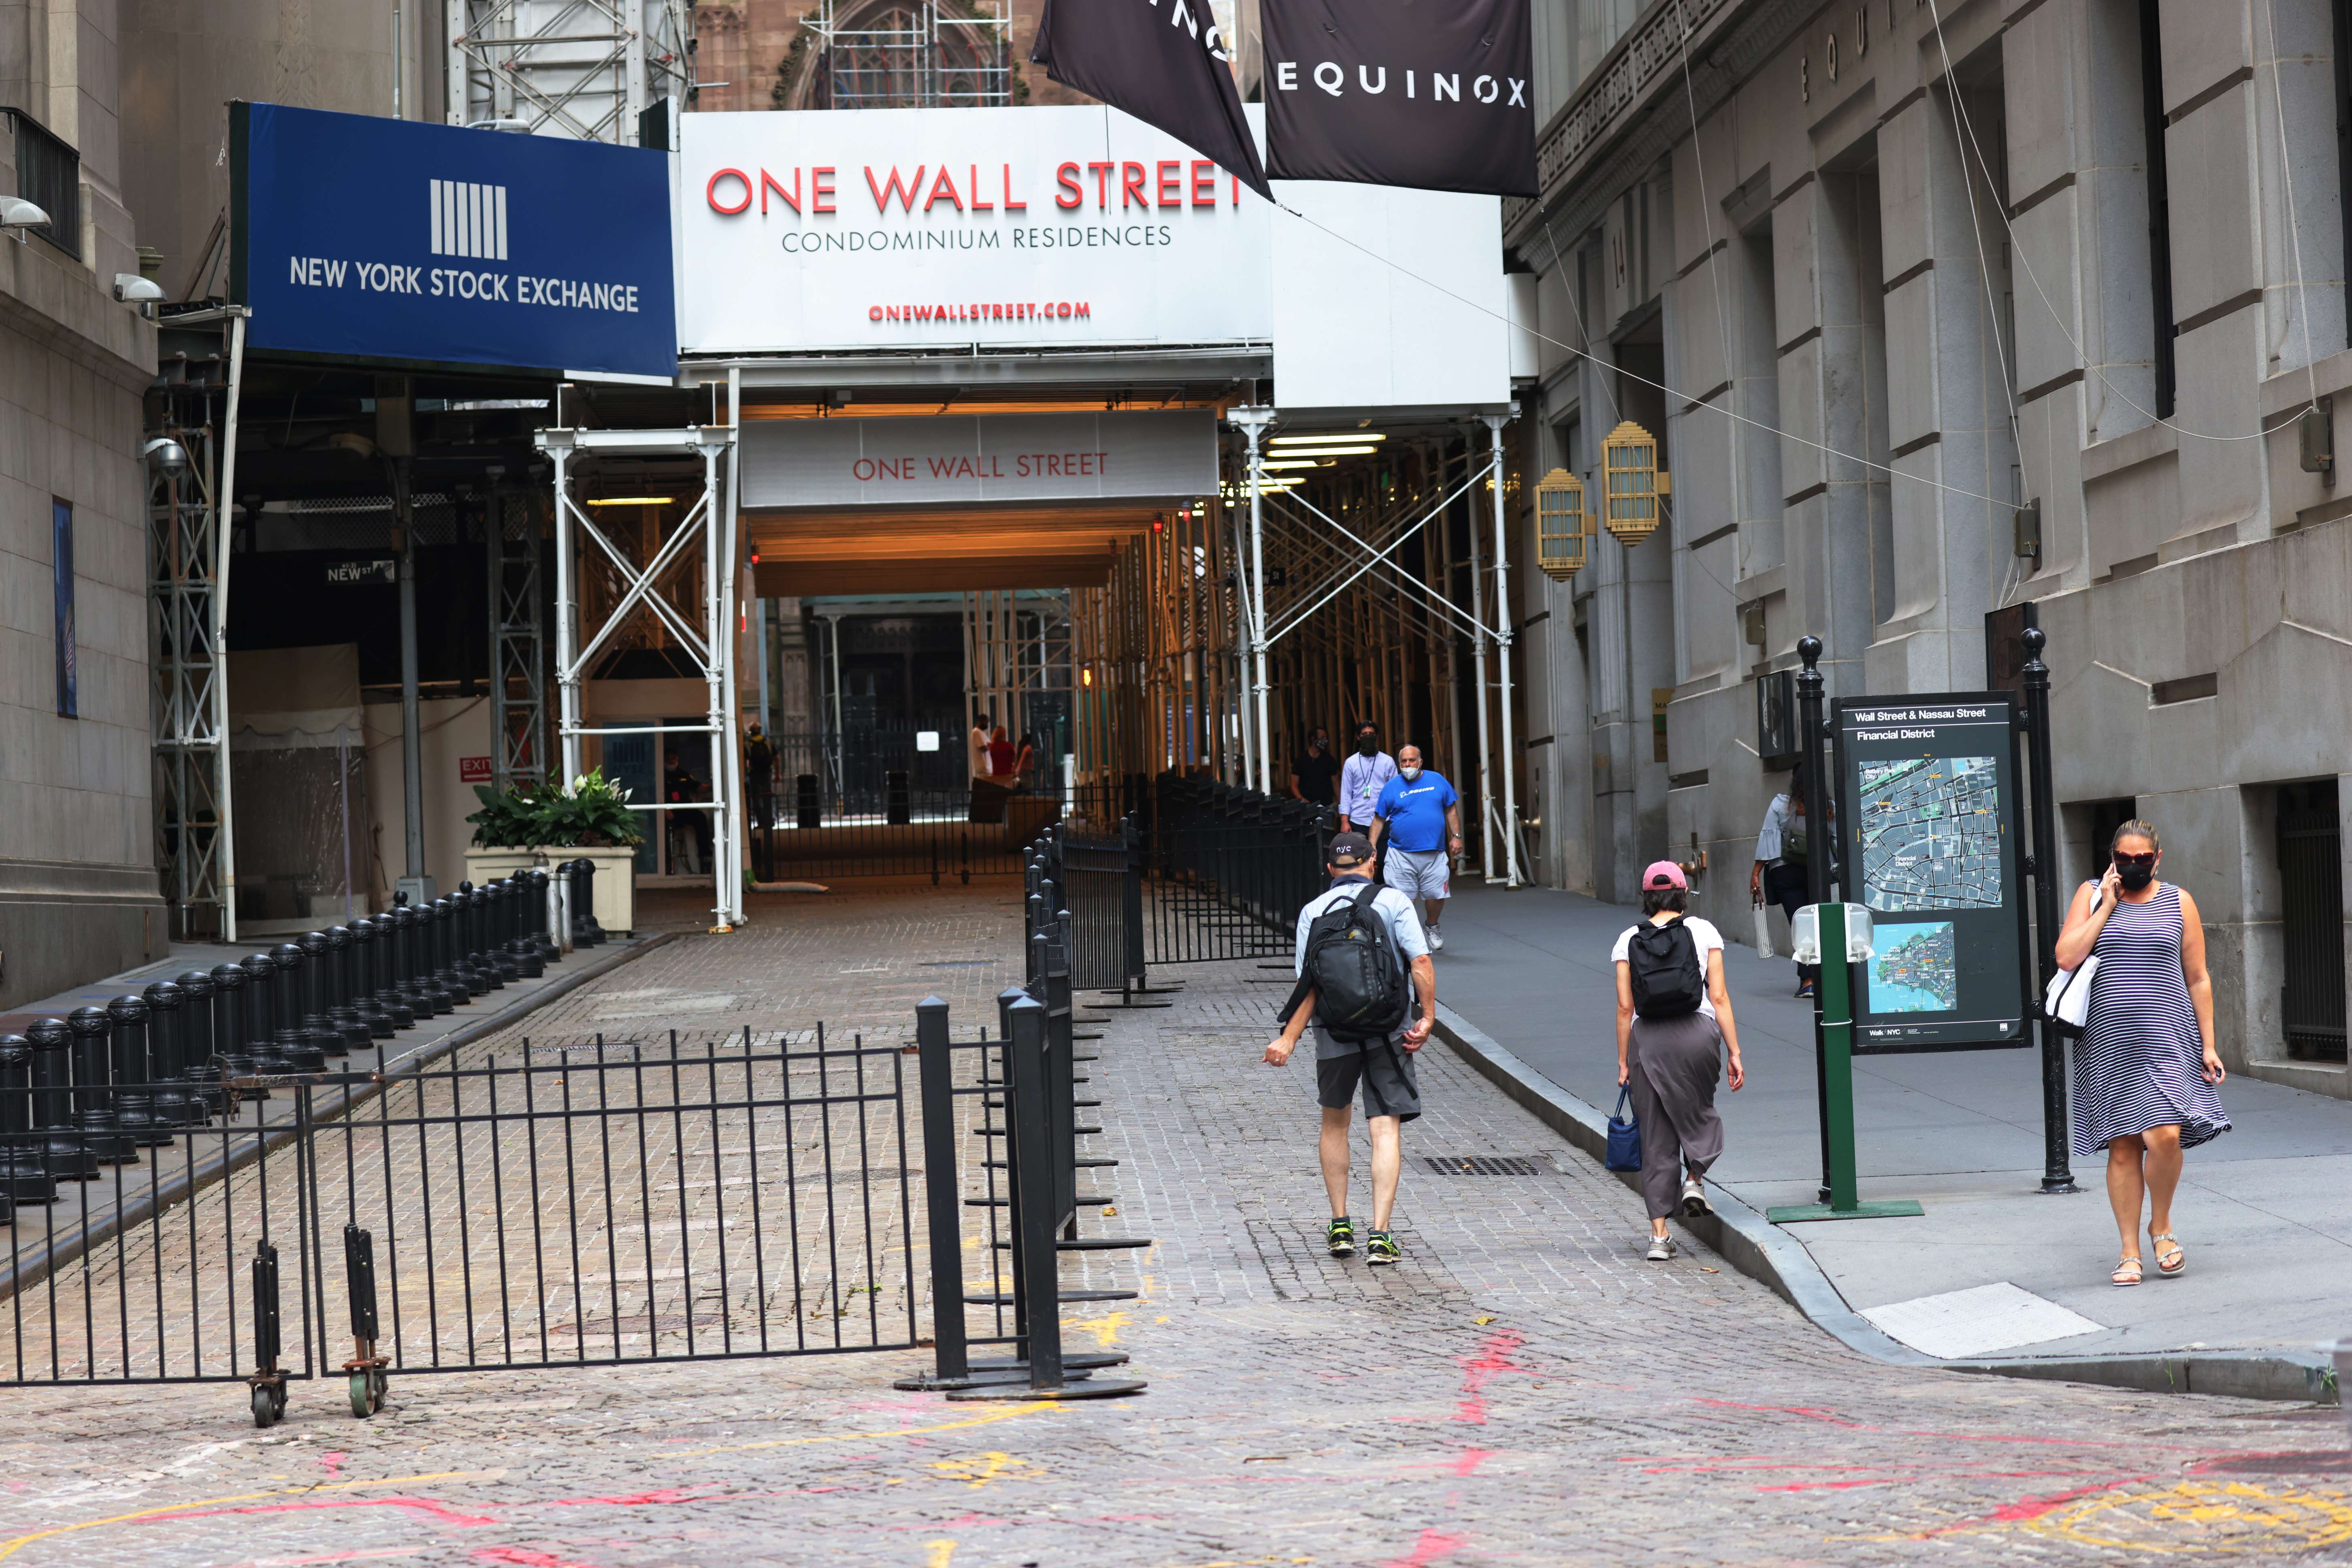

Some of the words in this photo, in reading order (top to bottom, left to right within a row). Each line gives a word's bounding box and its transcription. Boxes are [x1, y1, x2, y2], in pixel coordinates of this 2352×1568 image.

[1278, 62, 1525, 109] EQUINOX
[707, 166, 837, 215] ONE
[864, 163, 1027, 212] WALL
[782, 230, 999, 253] CONDOMINIUM
[1014, 226, 1171, 248] RESIDENCES
[290, 256, 347, 288] NEW
[355, 262, 422, 294] YORK
[430, 268, 509, 301] STOCK
[518, 276, 639, 312] EXCHANGE
[869, 302, 1091, 320] ONEWALLSTREET.COM
[853, 457, 916, 481] ONE
[927, 456, 1005, 478] WALL
[1016, 453, 1109, 477] STREET
[328, 568, 360, 581] NEW
[1855, 712, 1875, 722] Wall
[1877, 712, 1907, 721] Street
[1909, 711, 1917, 720] &
[1918, 709, 1955, 719] Nassau
[1956, 708, 1986, 718] Street
[1857, 730, 1898, 741] Financial
[1900, 729, 1935, 739] District
